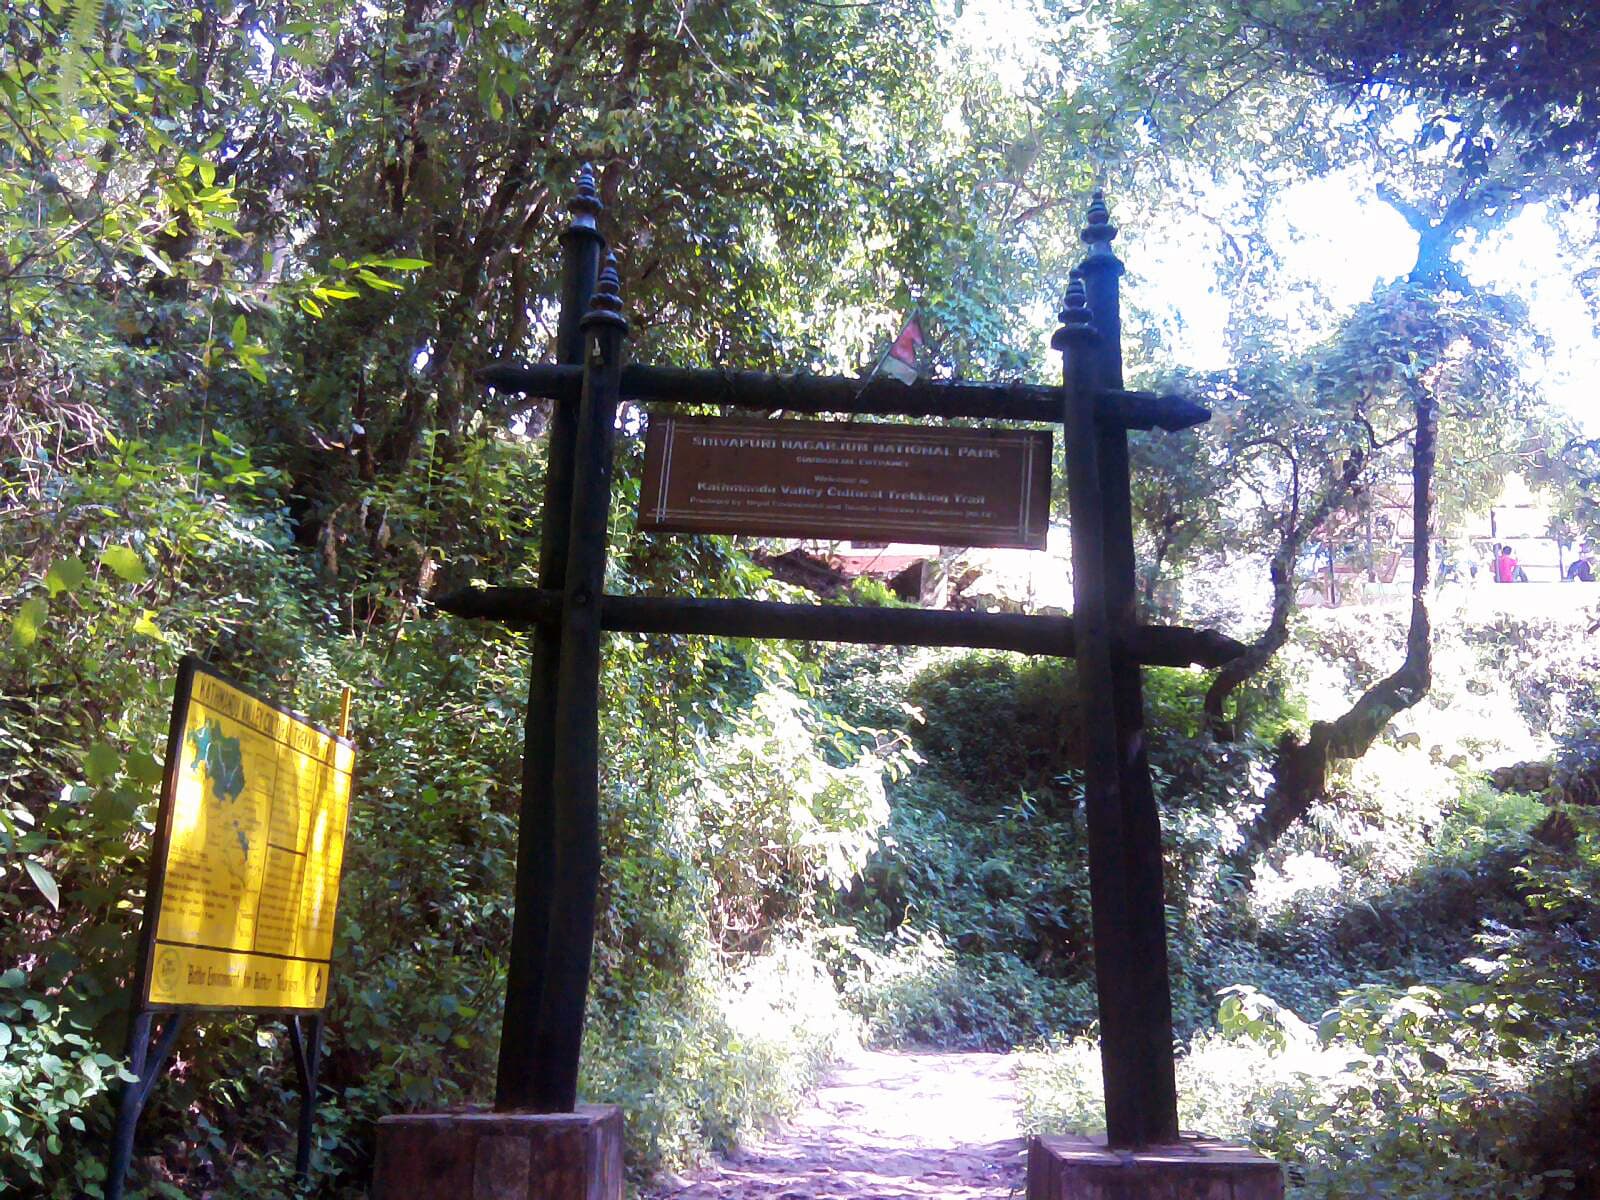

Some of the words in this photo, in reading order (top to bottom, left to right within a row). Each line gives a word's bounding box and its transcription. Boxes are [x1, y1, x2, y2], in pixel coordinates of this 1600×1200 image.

[692, 437, 776, 449] SHIVAPURI
[782, 440, 868, 453] NAGARJUN
[873, 444, 951, 457] NATIONAL
[958, 447, 1000, 458] PARK
[697, 482, 776, 494] Kathmandu
[781, 484, 823, 498] Valley
[827, 487, 883, 499] Cultural
[888, 490, 949, 504] Trekking
[954, 493, 986, 505] Trail
